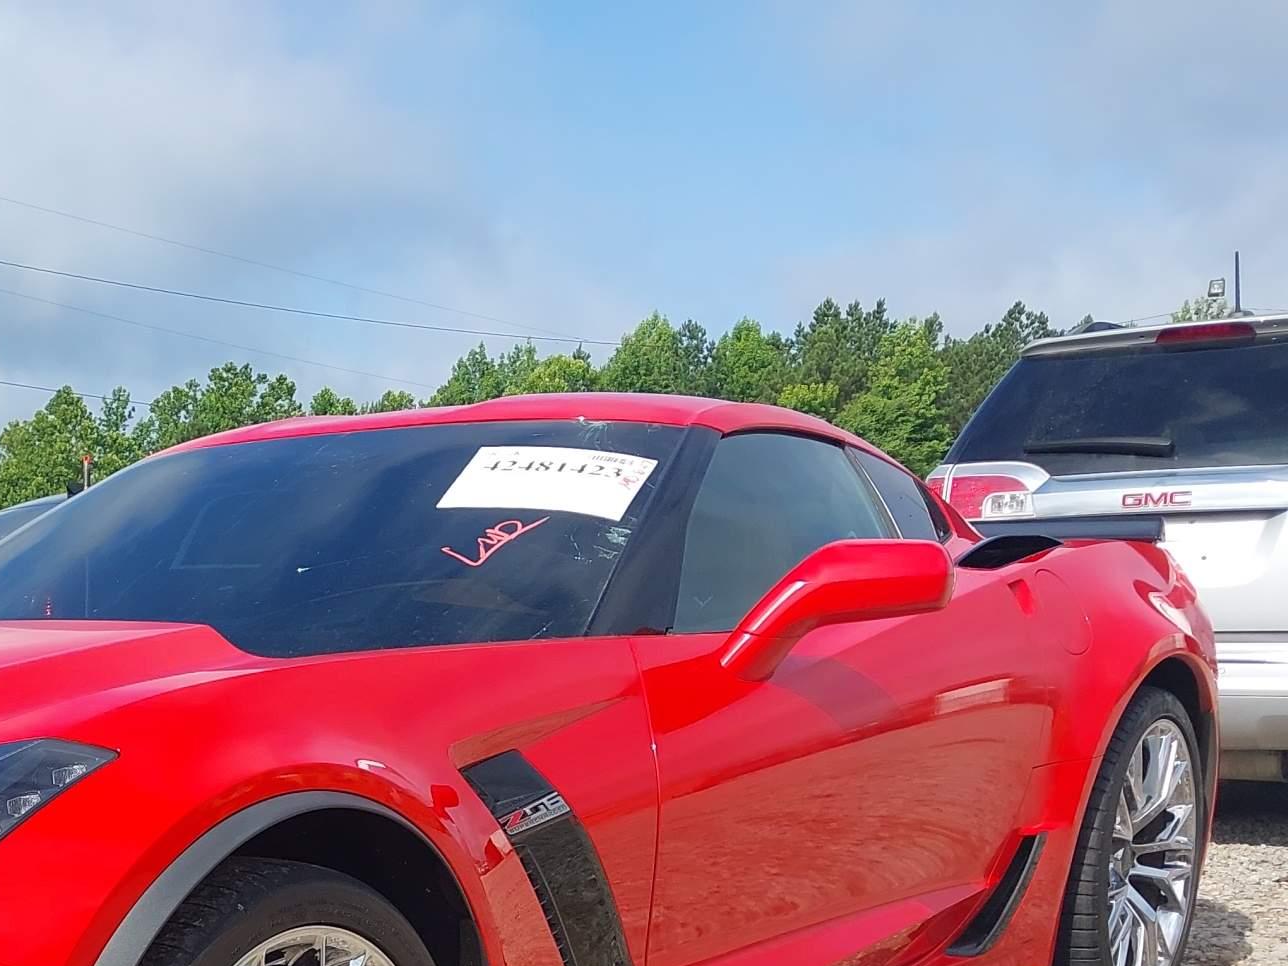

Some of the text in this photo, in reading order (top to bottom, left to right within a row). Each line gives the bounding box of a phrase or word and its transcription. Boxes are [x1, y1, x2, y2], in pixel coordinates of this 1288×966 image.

[483, 460, 623, 477] 42481423
[1122, 491, 1192, 508] GMC
[498, 791, 564, 829] Z06
